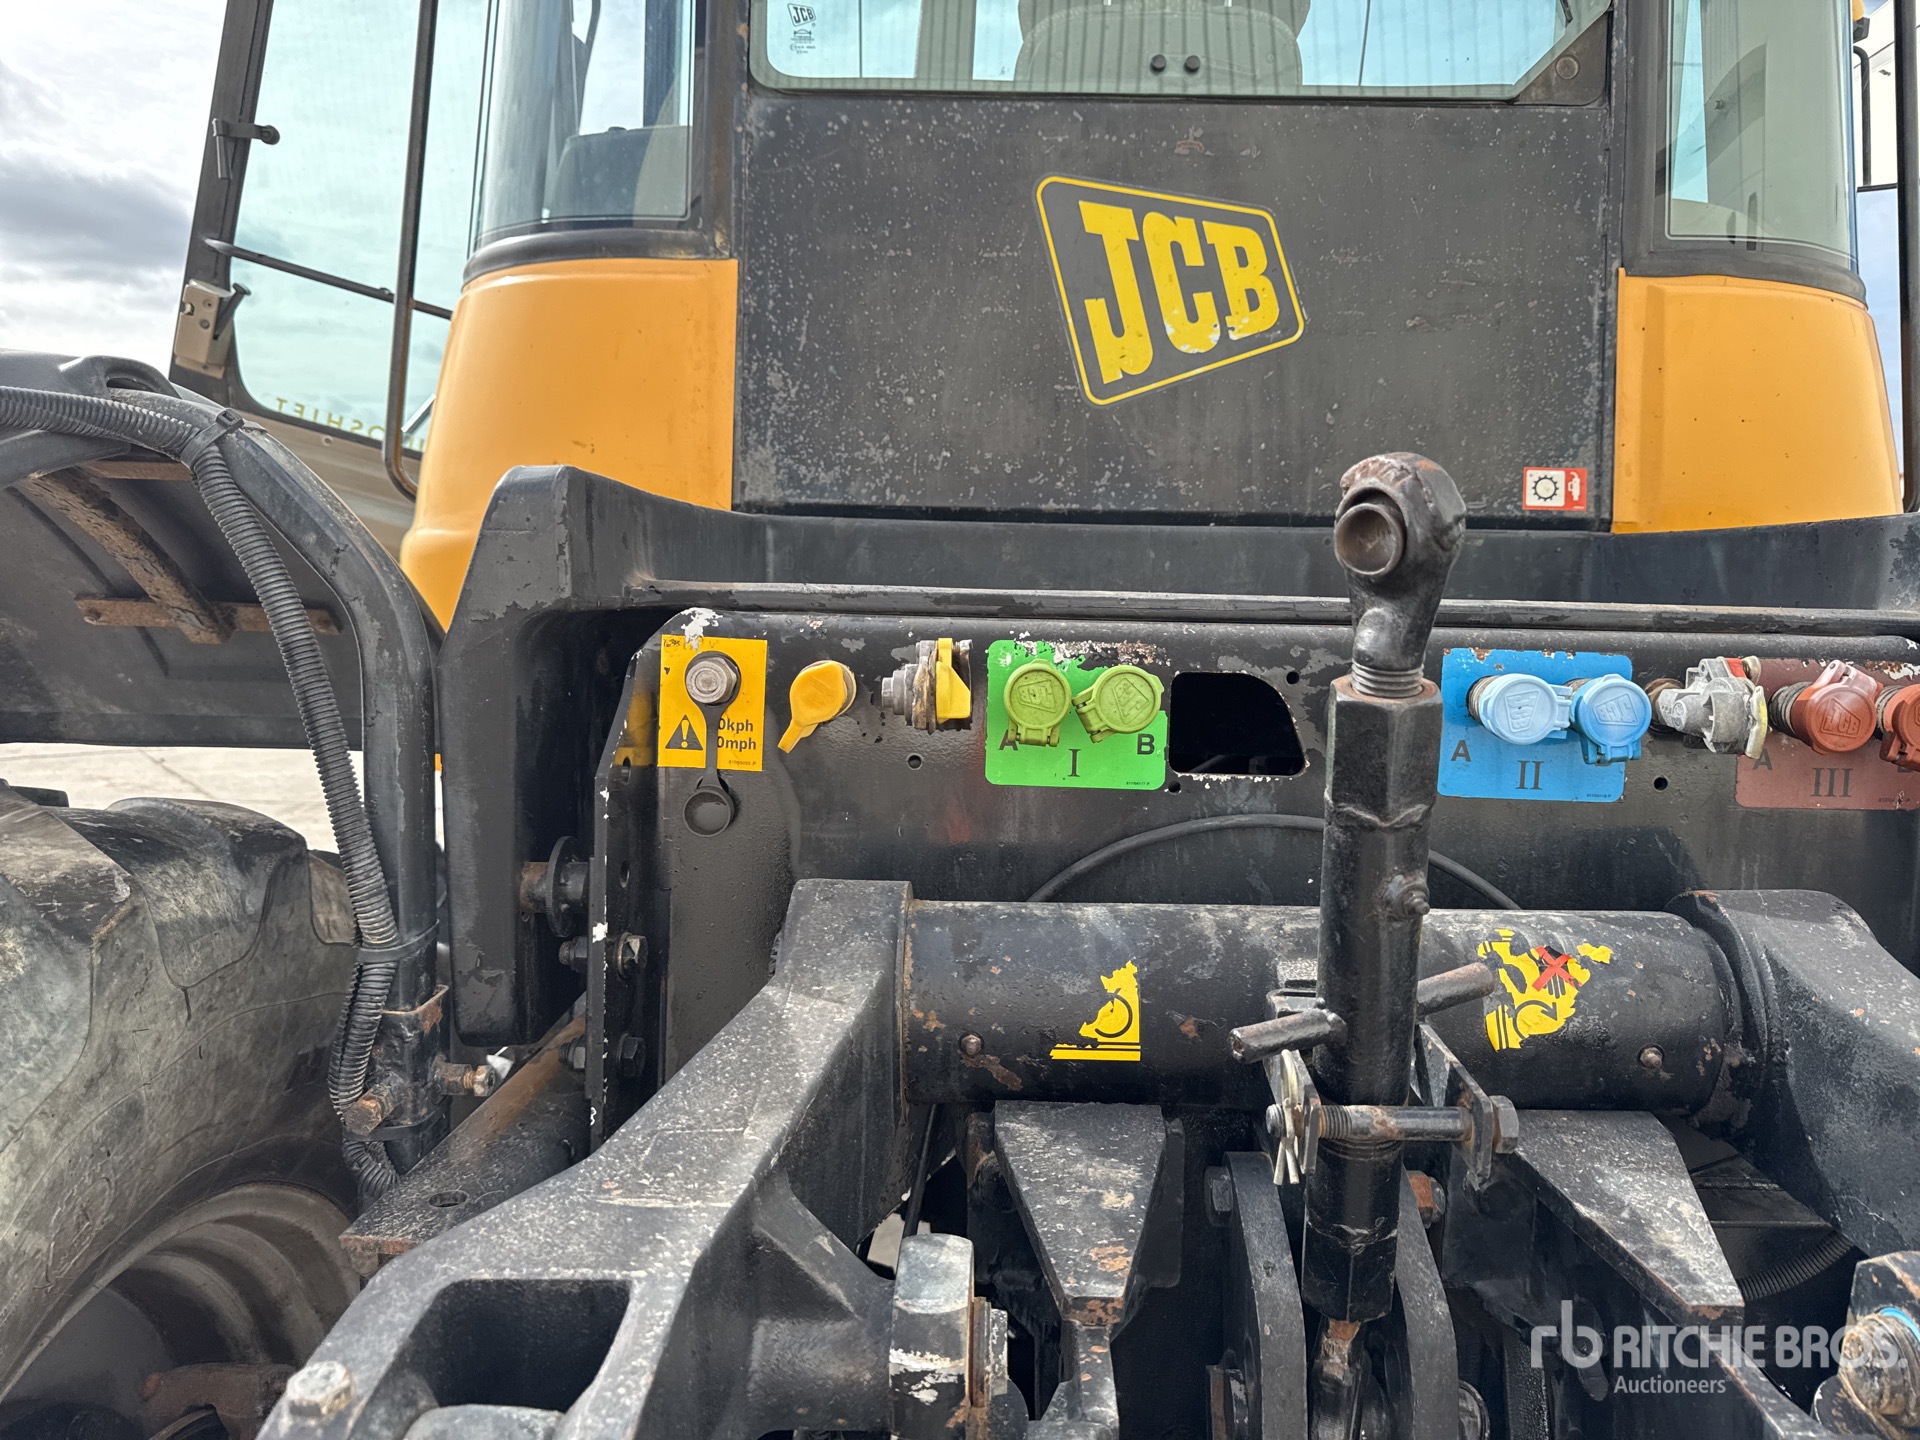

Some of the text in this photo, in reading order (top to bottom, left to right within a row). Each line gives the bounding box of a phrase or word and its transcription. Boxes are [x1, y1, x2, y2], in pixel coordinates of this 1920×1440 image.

[792, 6, 814, 24] JCB
[1078, 200, 1280, 385] JCB
[718, 717, 753, 734] 0kph
[1823, 703, 1859, 735] JCB
[717, 735, 756, 752] 0mph
[999, 729, 1018, 750] A
[1137, 733, 1155, 755] B
[1450, 739, 1471, 762] A
[1068, 748, 1081, 777] I
[1753, 748, 1773, 770] A
[1515, 760, 1545, 790] II
[1811, 767, 1854, 797] III
